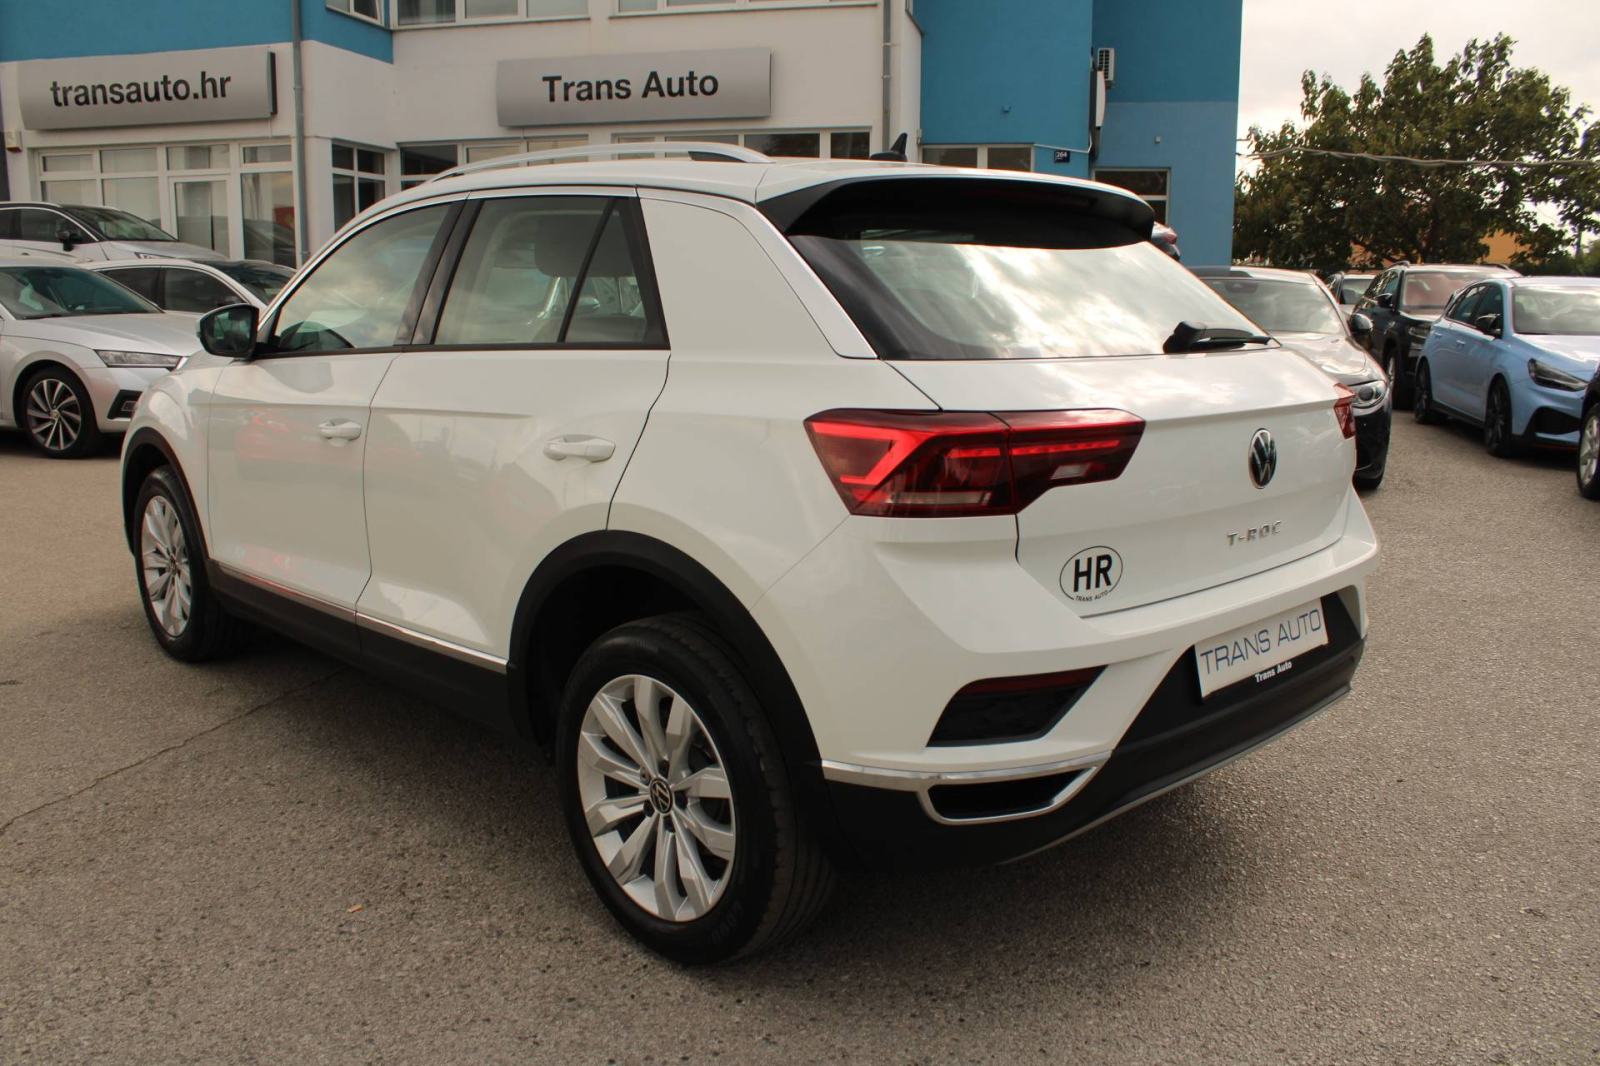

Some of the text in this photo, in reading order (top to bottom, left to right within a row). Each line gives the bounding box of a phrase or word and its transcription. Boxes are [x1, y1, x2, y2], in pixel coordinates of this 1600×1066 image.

[50, 71, 232, 108] transauto.hr
[541, 70, 719, 104] Trans Auto
[1226, 520, 1282, 546] T-ROC
[1074, 554, 1112, 592] HR
[1094, 590, 1108, 600] AUTO
[1200, 609, 1322, 675] TRANS AUTO
[1255, 660, 1292, 683] Trans Auto
